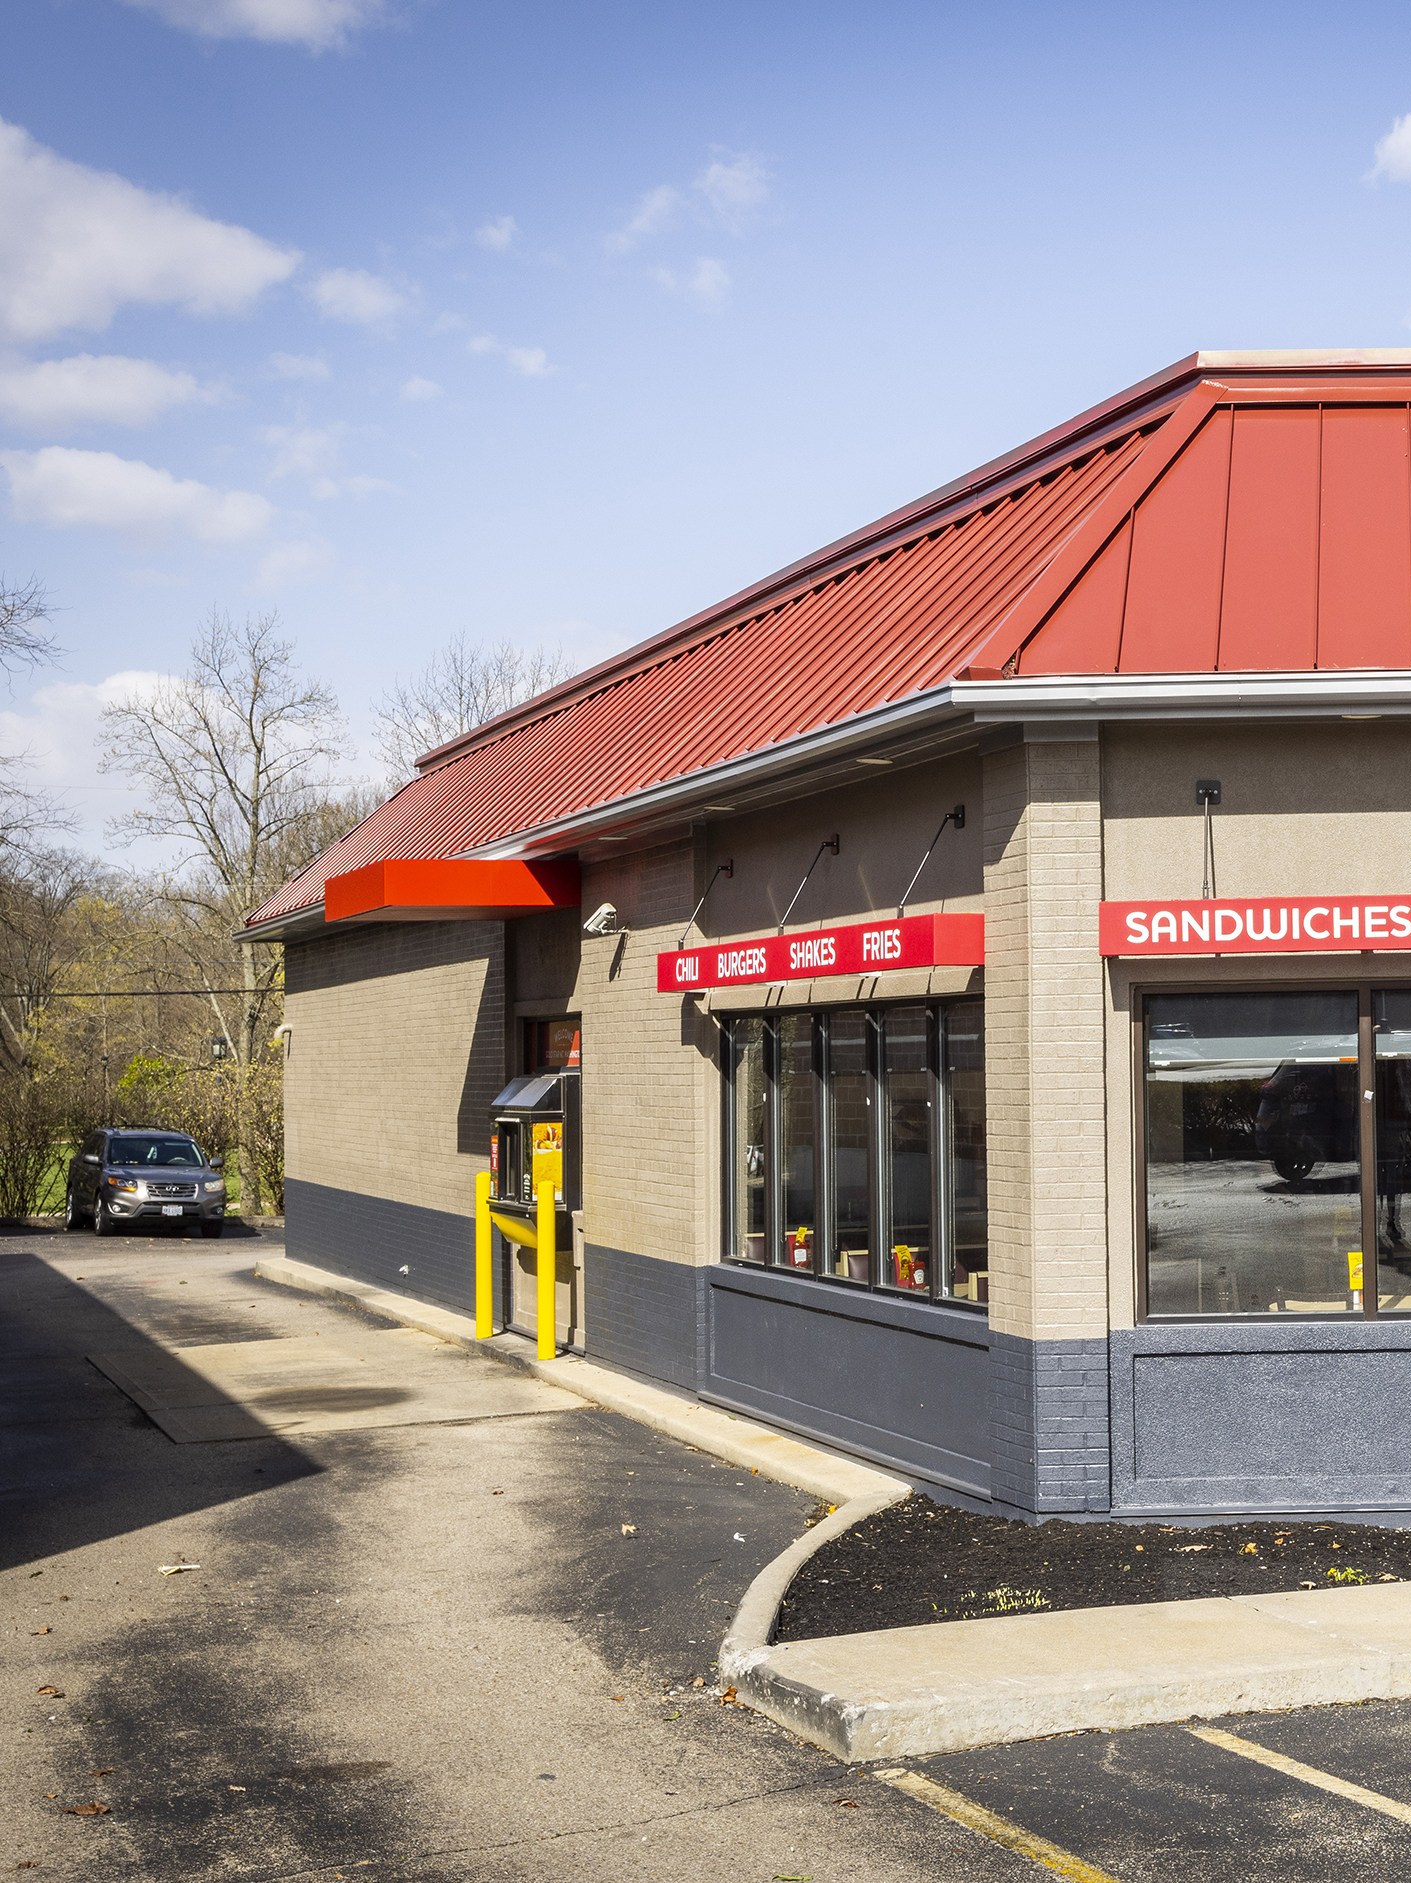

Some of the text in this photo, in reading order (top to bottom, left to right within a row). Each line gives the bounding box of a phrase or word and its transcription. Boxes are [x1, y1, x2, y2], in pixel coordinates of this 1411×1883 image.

[675, 928, 902, 983] CHILI BURGERS SHAKES FRIES
